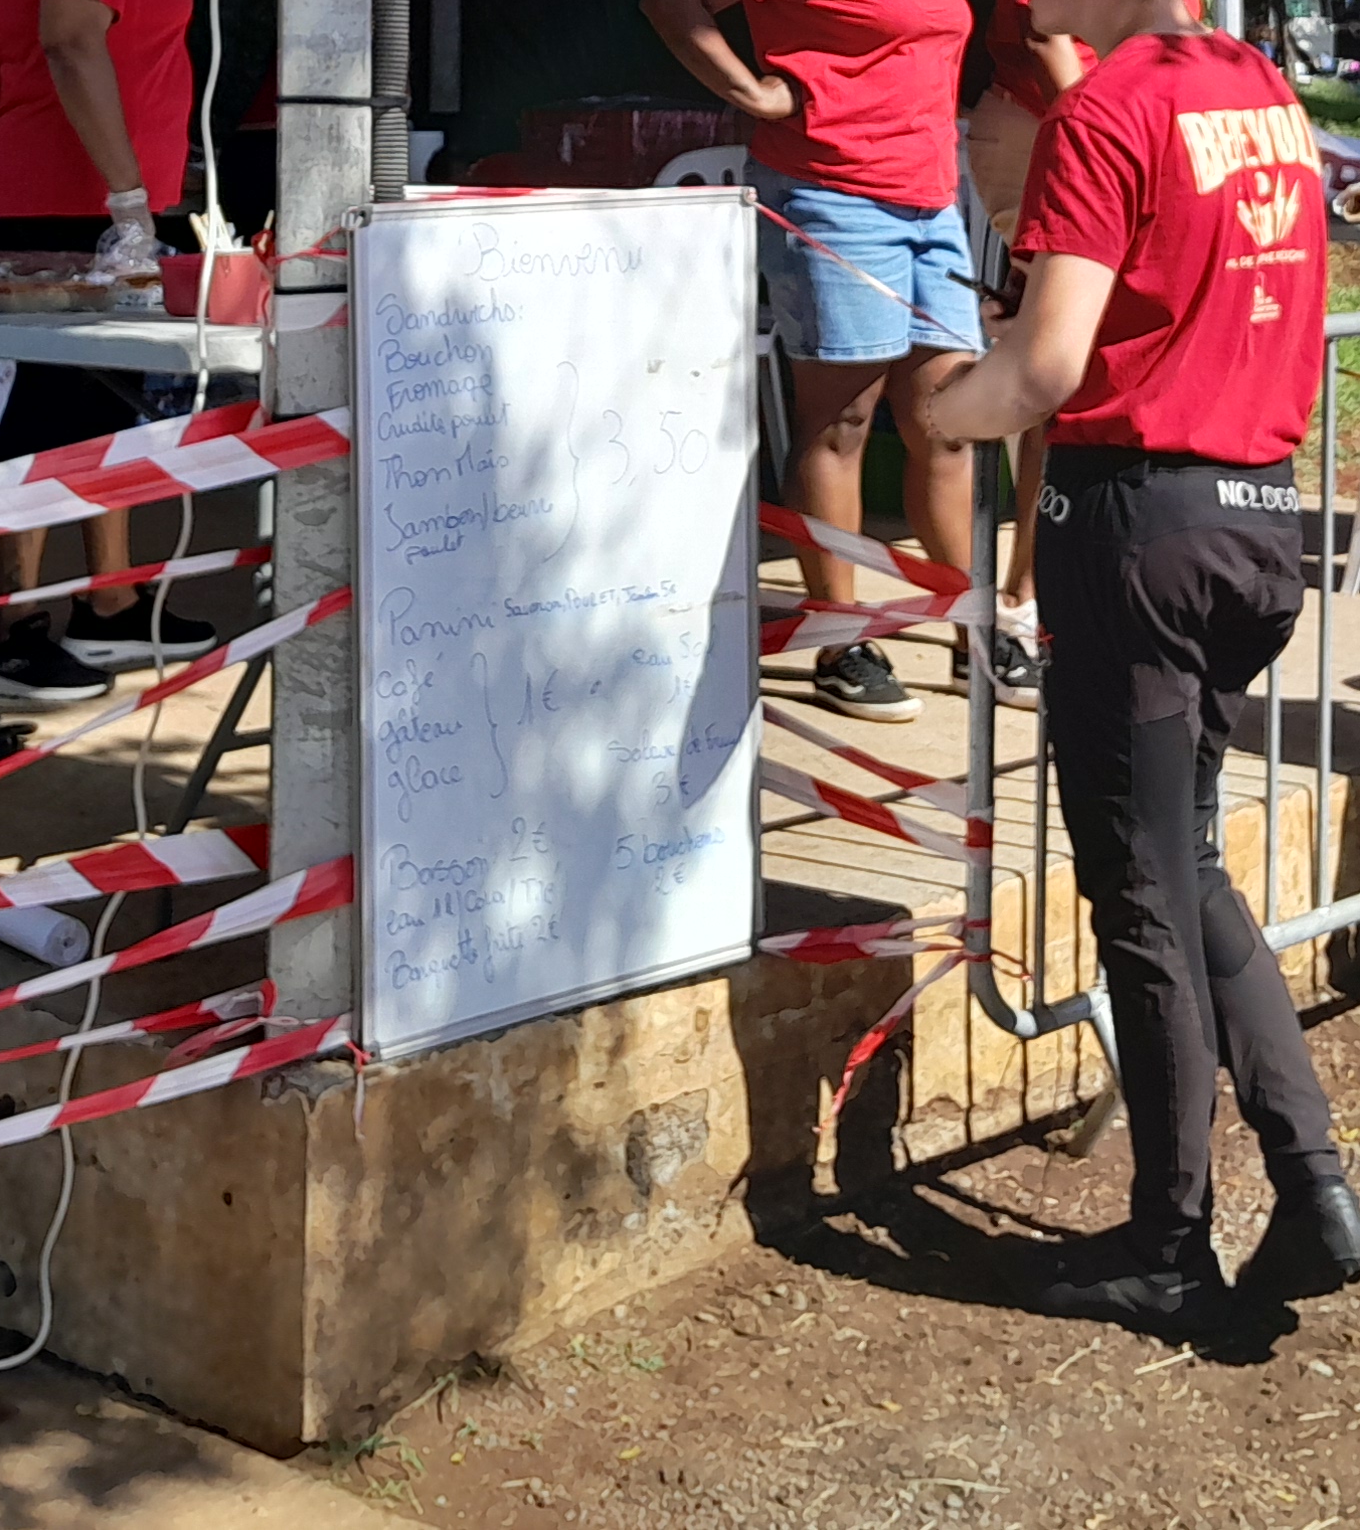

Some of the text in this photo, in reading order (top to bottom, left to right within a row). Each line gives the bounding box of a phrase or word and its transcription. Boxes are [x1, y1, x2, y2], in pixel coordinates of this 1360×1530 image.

[377, 333, 494, 374] Bouchon
[385, 373, 494, 413] Fromage
[378, 453, 452, 490] Thon
[379, 585, 496, 647] Panini
[376, 650, 443, 706] Café
[387, 754, 463, 824] glace
[615, 833, 636, 870] 5
